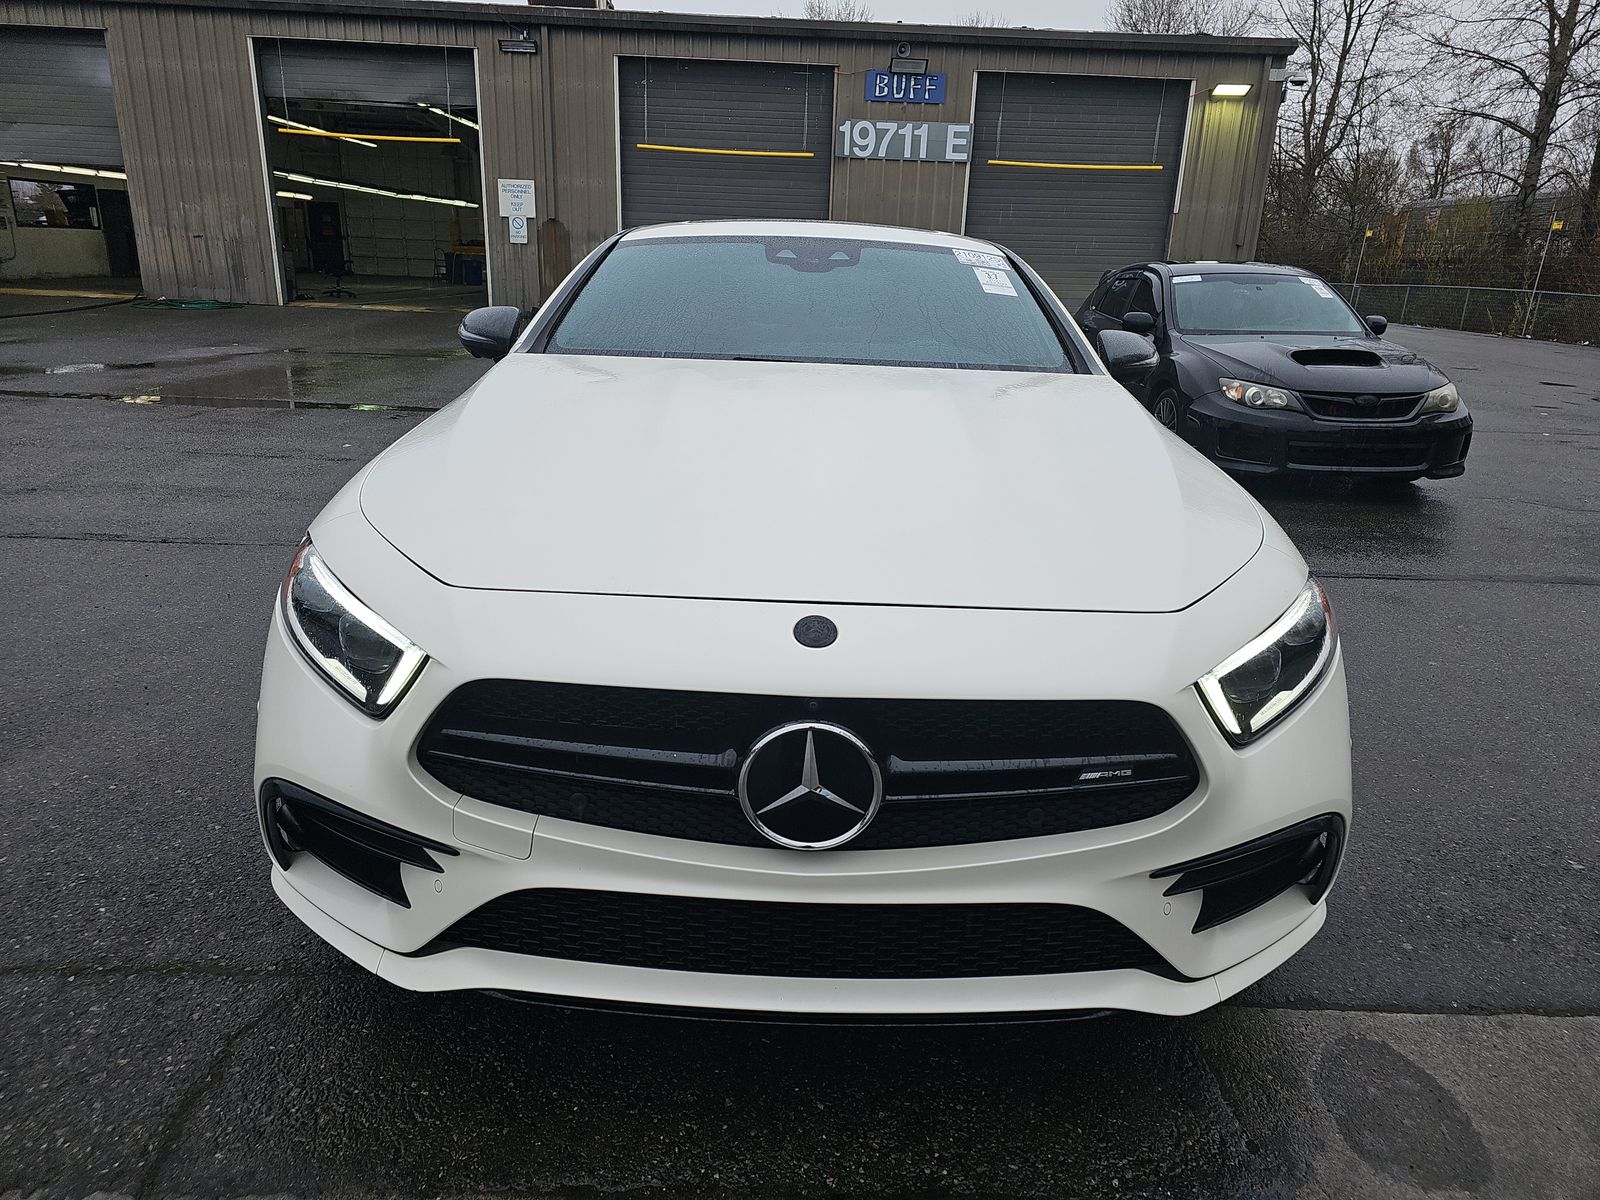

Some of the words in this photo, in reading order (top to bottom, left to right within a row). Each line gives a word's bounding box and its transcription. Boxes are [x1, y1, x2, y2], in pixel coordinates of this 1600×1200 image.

[875, 74, 937, 99] BUFF
[839, 120, 929, 158] 19711
[945, 124, 970, 160] E
